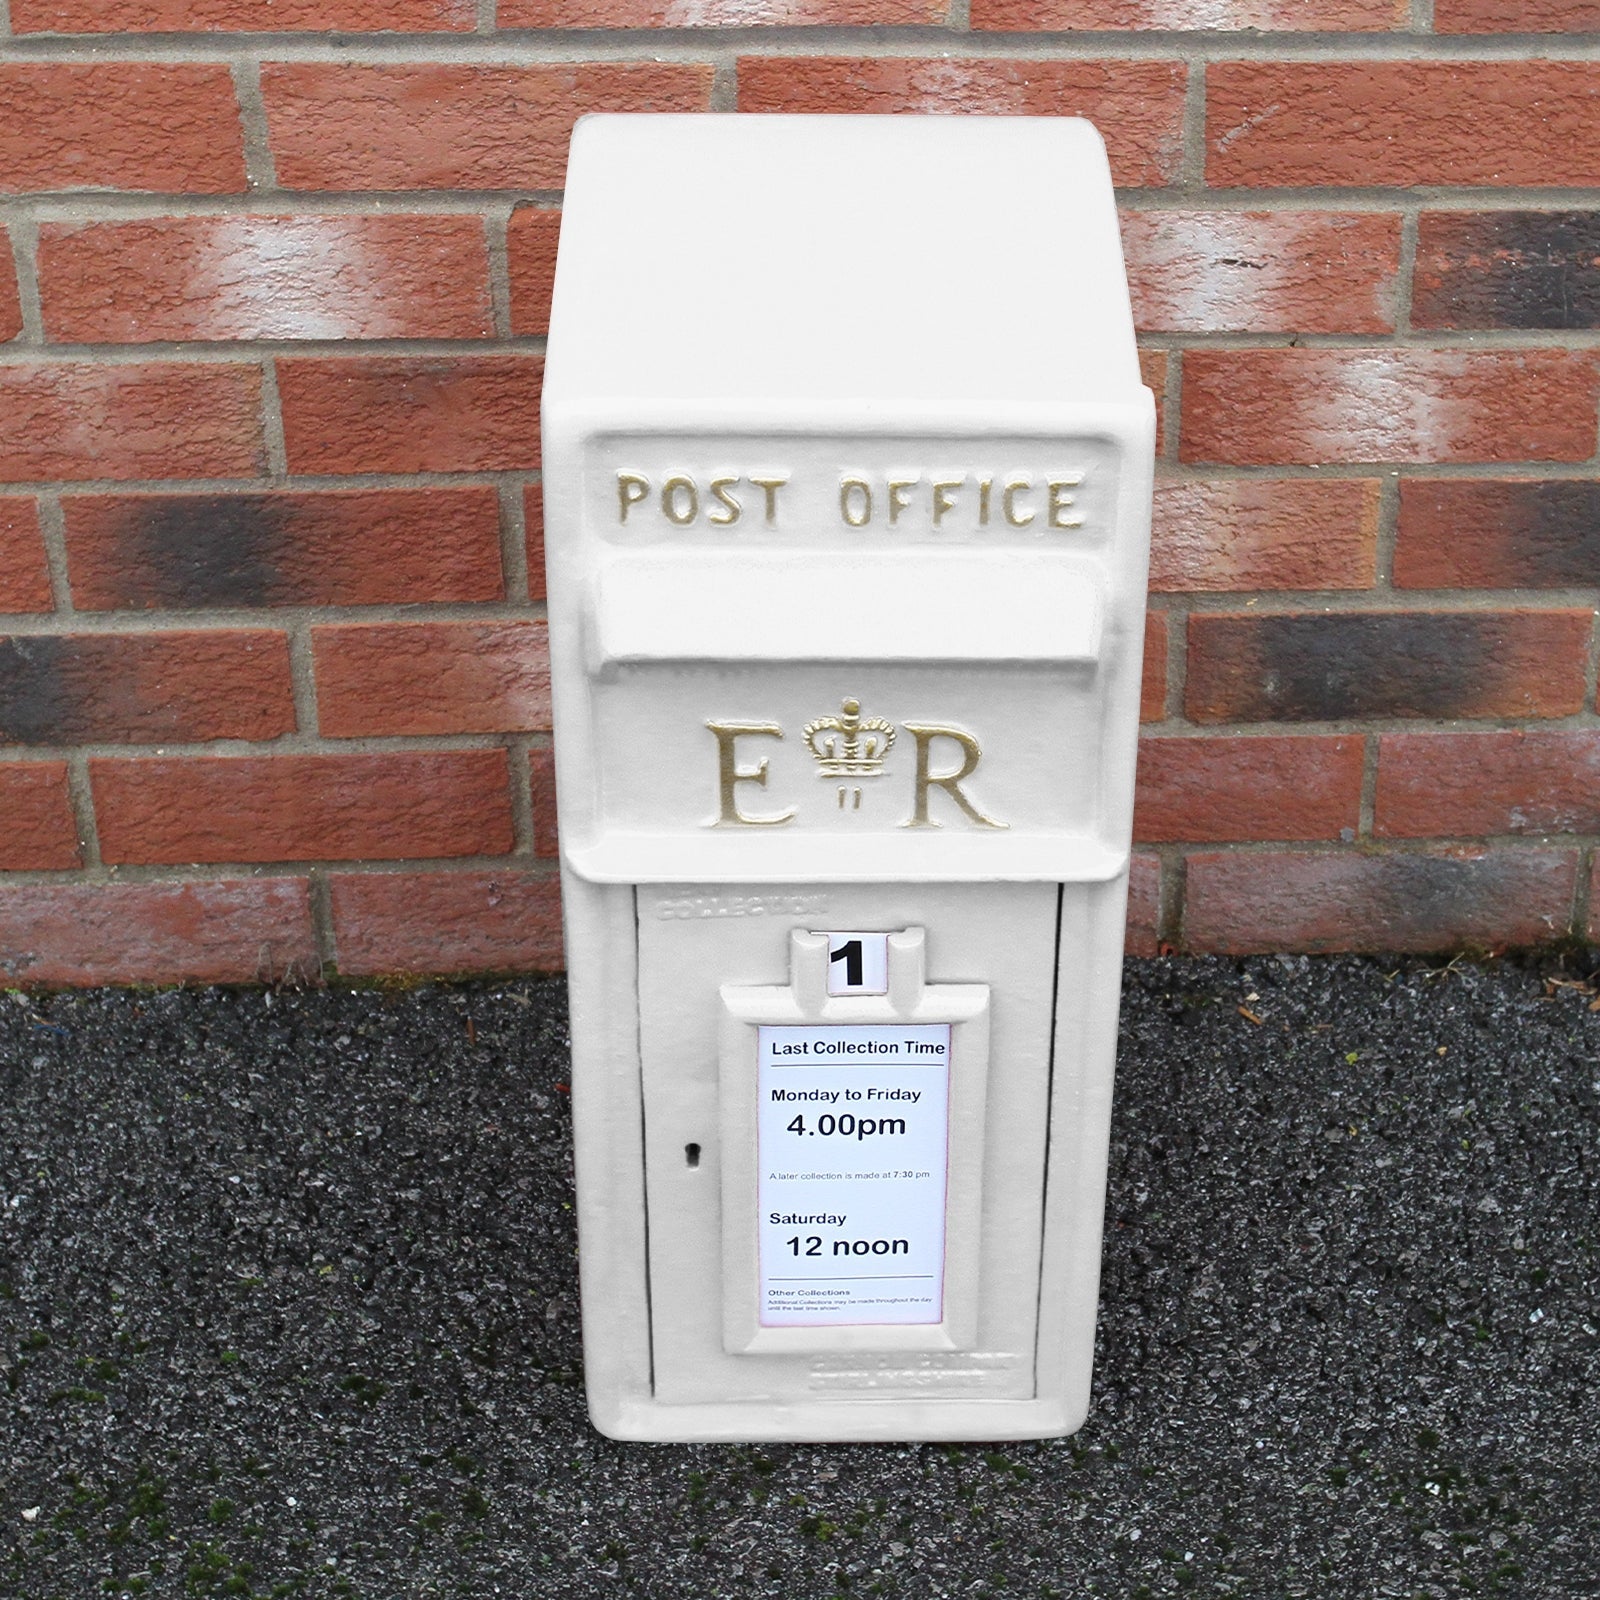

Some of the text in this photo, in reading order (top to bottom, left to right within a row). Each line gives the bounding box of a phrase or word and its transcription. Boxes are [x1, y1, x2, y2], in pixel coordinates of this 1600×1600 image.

[615, 469, 1085, 530] POST OFFICE
[704, 719, 1011, 829] E R
[830, 940, 863, 986] 1
[772, 1040, 945, 1055] Last Collection Time
[771, 1088, 921, 1104] Monday to Friday
[787, 1114, 906, 1141] 4.00pm
[769, 1170, 931, 1180] A later collection is made at 7:30 pm
[769, 1212, 847, 1227] Saturday
[786, 1236, 910, 1257] 12 noon
